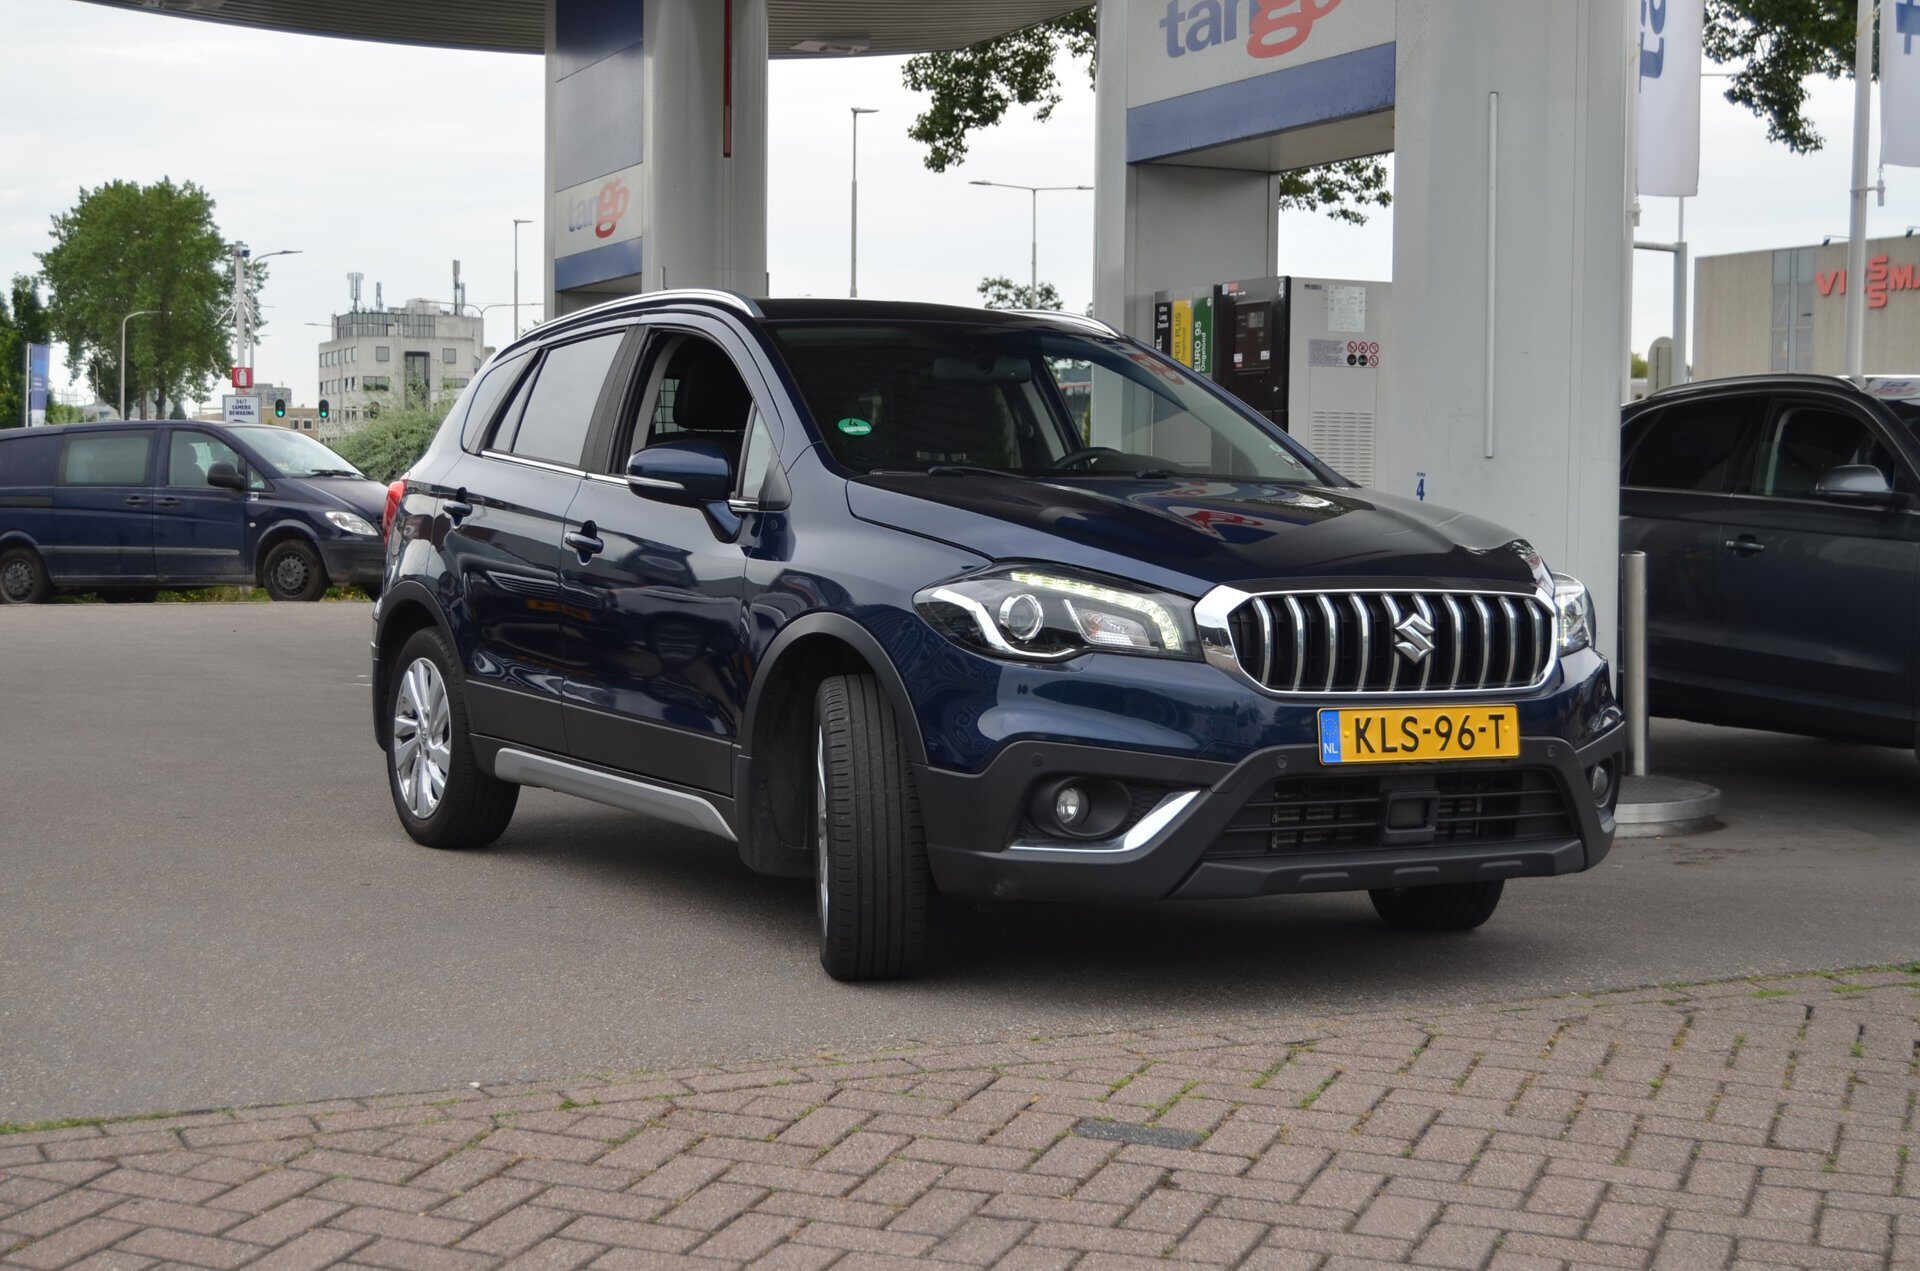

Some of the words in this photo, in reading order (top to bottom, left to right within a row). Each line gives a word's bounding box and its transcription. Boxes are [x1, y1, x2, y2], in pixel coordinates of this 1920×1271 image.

[566, 177, 630, 238] tango
[1815, 254, 1920, 309] VISSM
[1174, 312, 1182, 338] PLUS
[1194, 321, 1202, 337] 95
[1194, 340, 1202, 373] EURO
[1416, 478, 1425, 501] 4
[1323, 742, 1339, 755] NL
[1354, 713, 1505, 755] KLS-96-T
